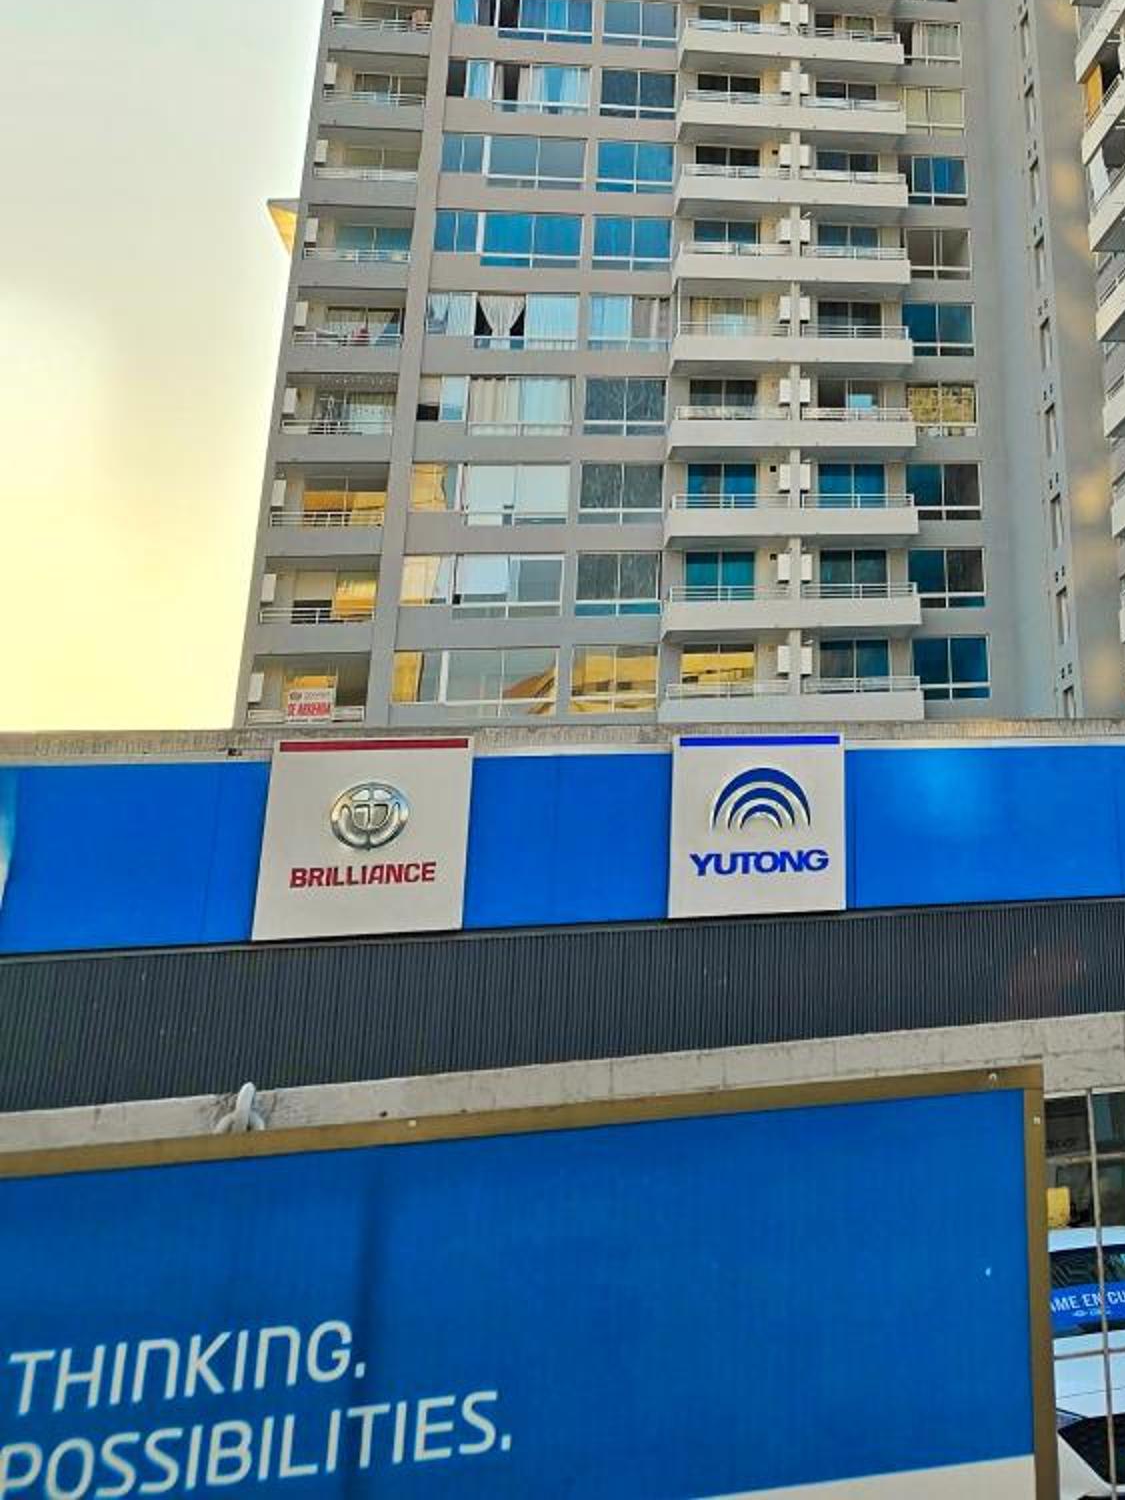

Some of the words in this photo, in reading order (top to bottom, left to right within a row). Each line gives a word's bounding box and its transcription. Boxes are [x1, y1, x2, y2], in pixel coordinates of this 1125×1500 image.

[289, 862, 437, 888] BRILLIANCE
[690, 850, 829, 876] YUTONG
[9, 1320, 366, 1416] THINKING.
[0, 1390, 512, 1500] POSSIBILITIES.
